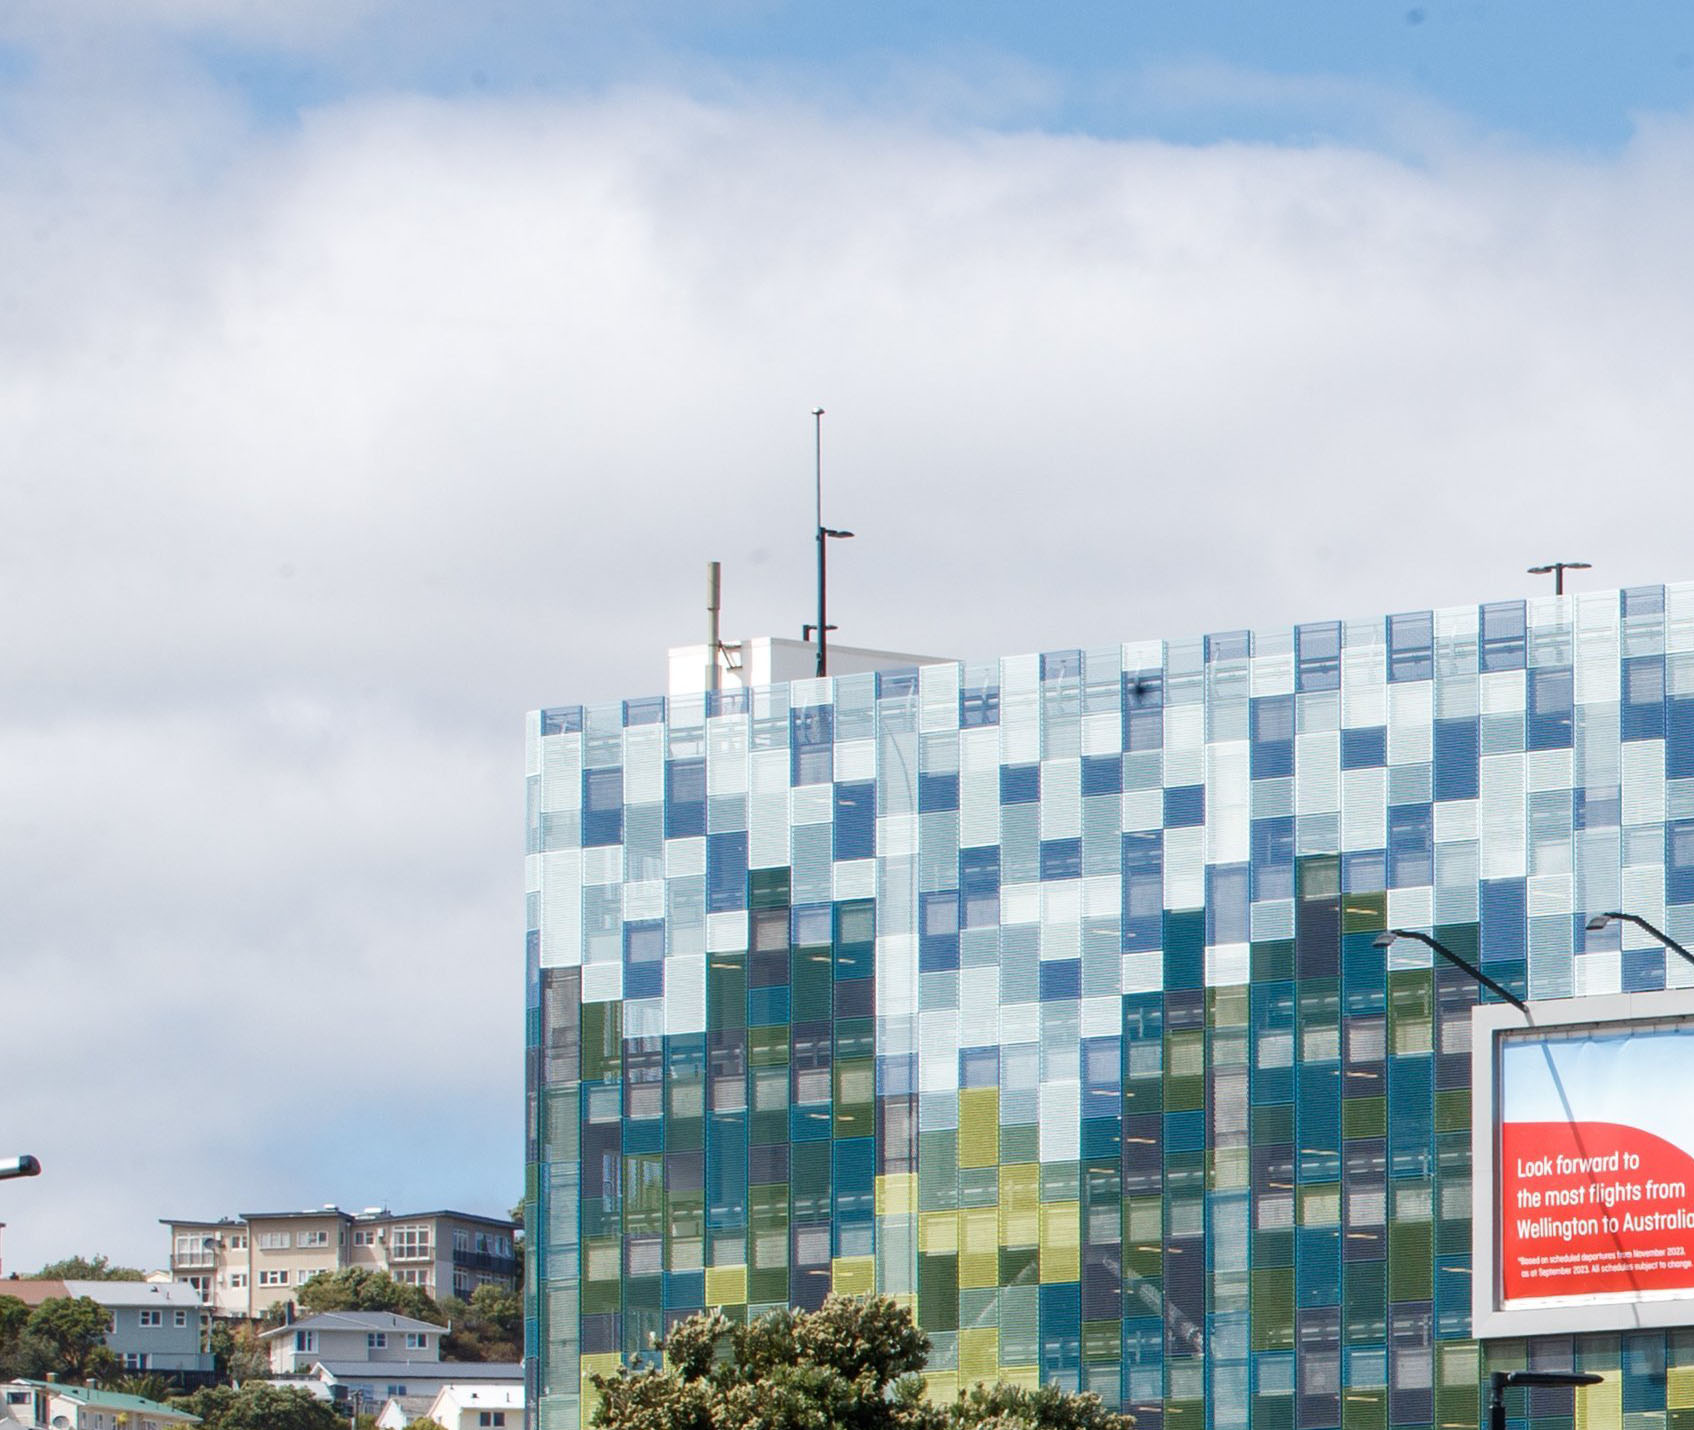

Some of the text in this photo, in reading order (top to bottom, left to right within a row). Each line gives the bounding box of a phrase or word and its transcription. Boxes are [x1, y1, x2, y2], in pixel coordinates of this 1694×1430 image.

[1517, 1151, 1640, 1178] Look forward to
[1517, 1180, 1686, 1208] the most flights from
[1517, 1217, 1599, 1241] Wellington
[1602, 1216, 1619, 1233] to
[1541, 1256, 1549, 1264] on
[1549, 1253, 1581, 1264] scheduled
[1581, 1251, 1616, 1263] departures
[1616, 1250, 1633, 1260] from
[1633, 1248, 1666, 1258] November
[1521, 1269, 1529, 1278] as
[1538, 1266, 1571, 1278] September
[1591, 1263, 1600, 1273] All
[1601, 1261, 1634, 1273] schedules
[1635, 1260, 1658, 1272] subject
[1659, 1260, 1667, 1269] to
